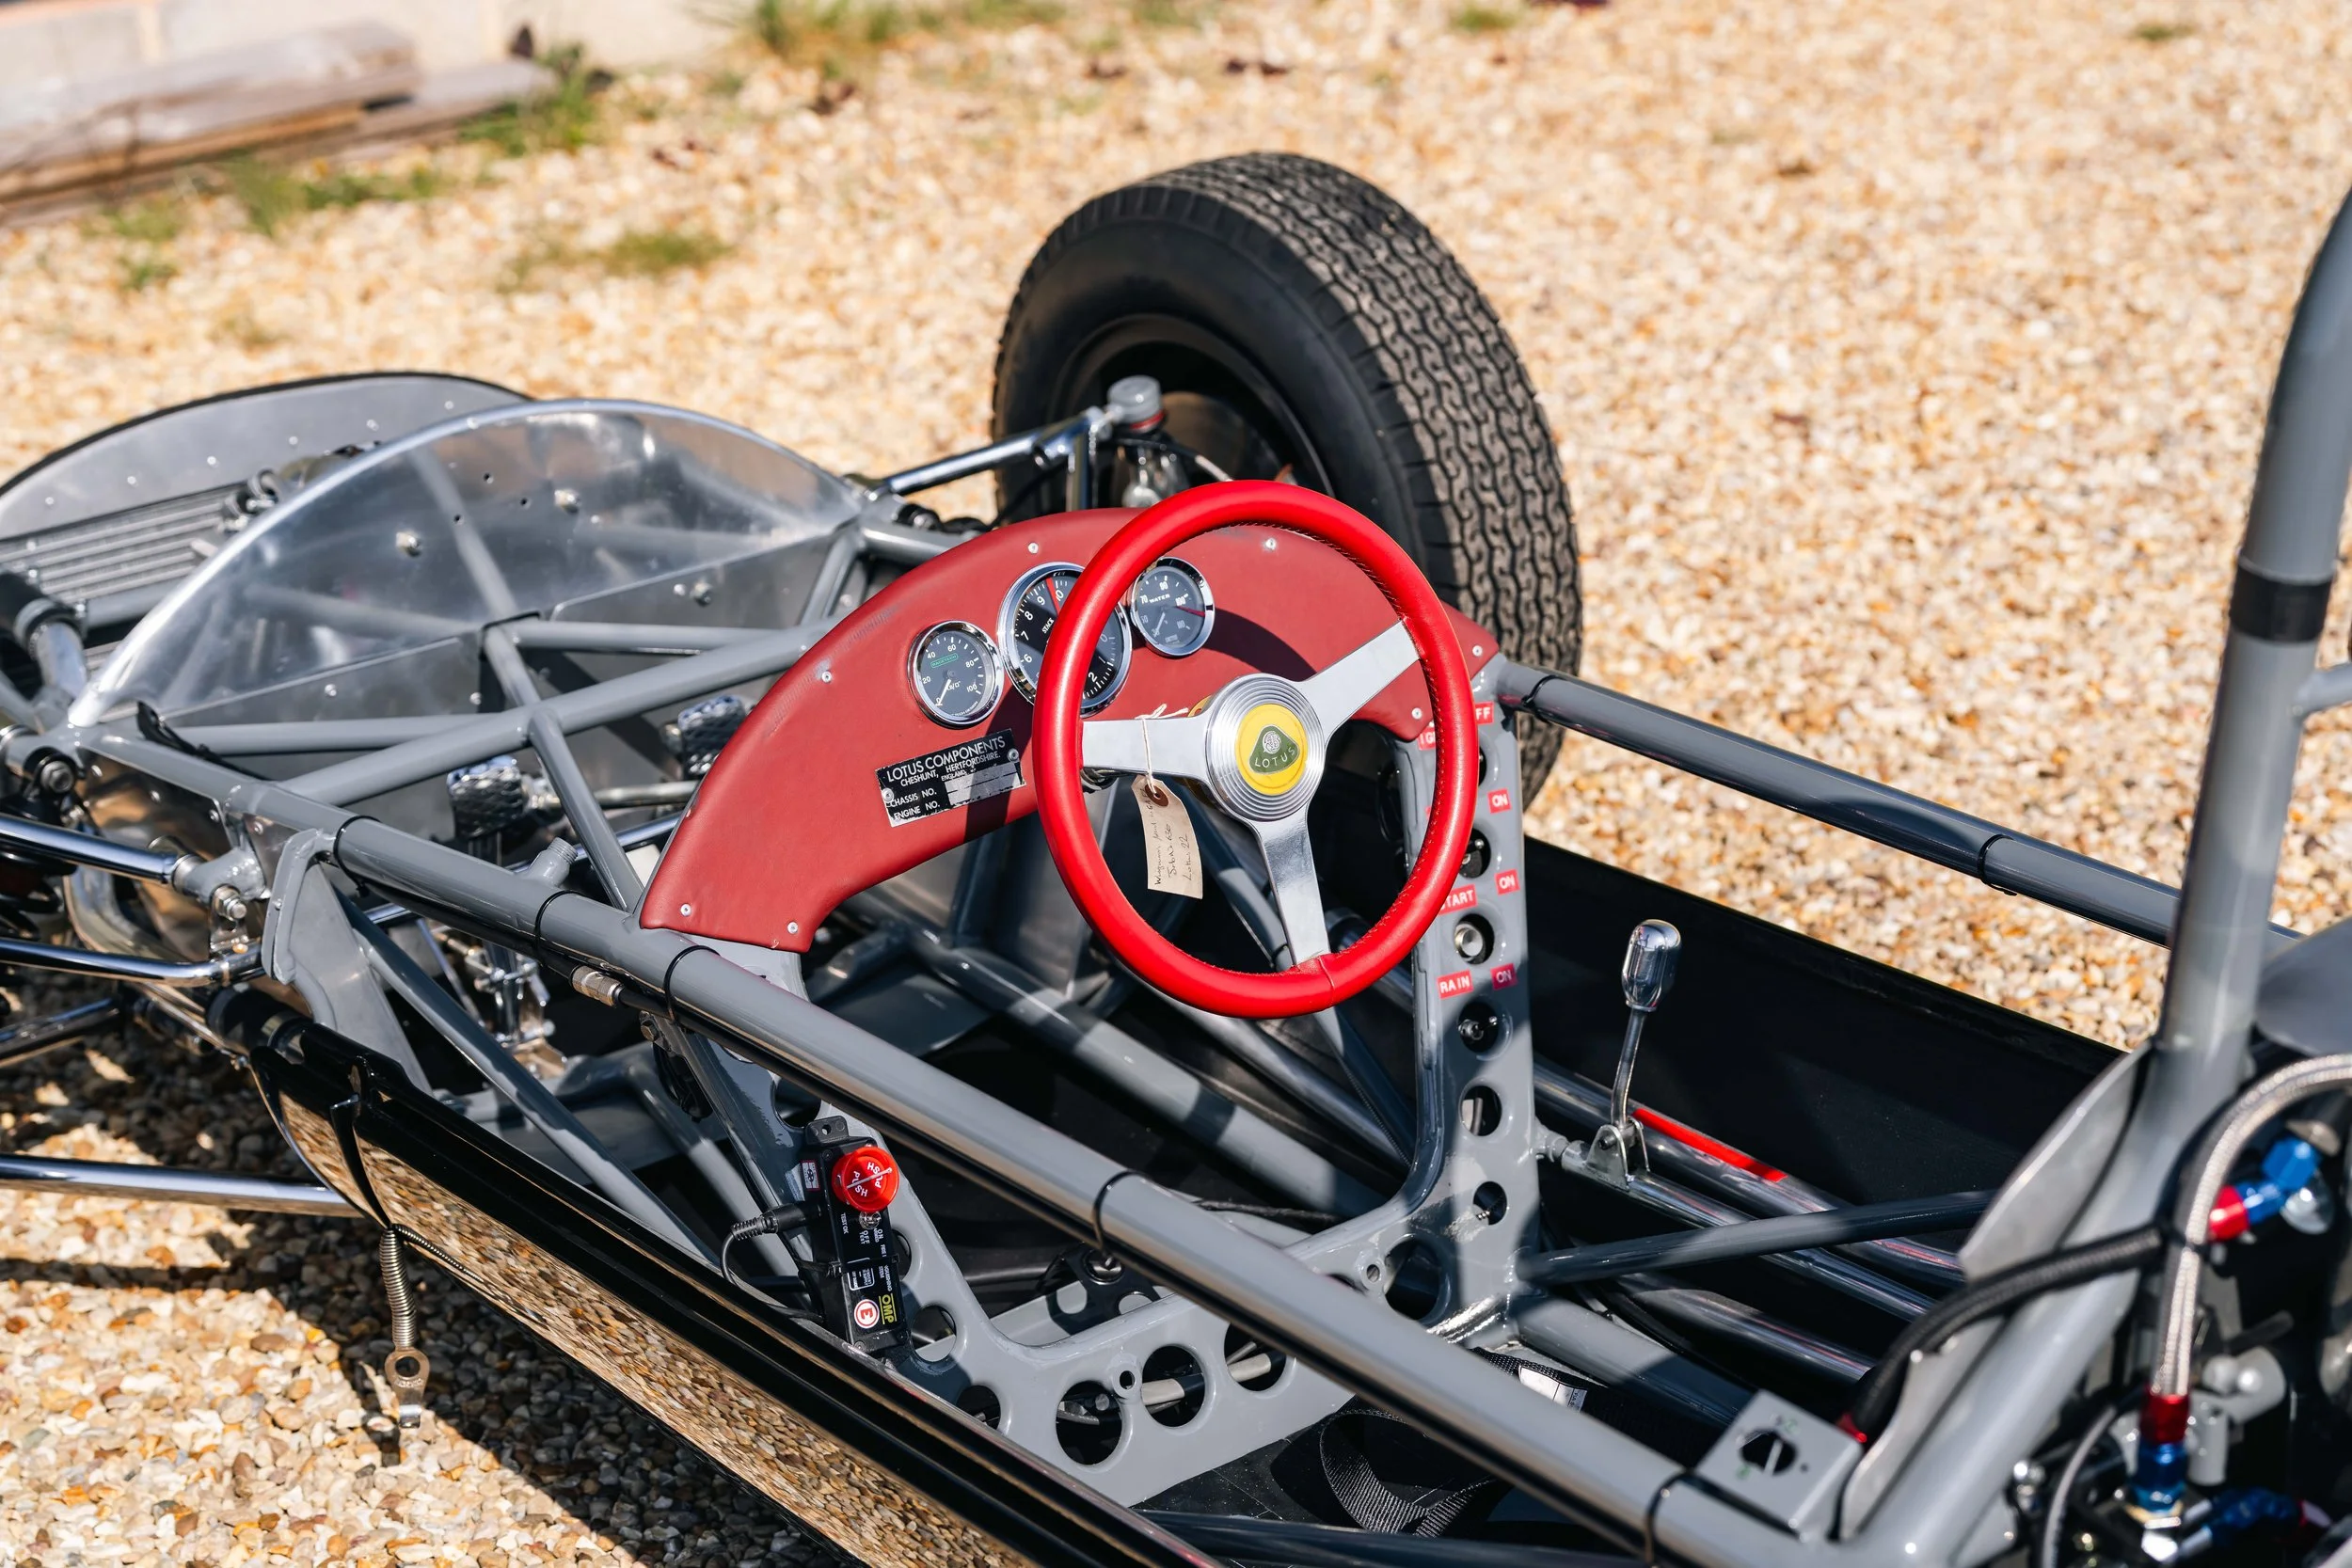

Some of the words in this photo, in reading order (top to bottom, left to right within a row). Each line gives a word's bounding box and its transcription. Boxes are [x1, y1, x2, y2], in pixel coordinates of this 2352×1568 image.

[1037, 596, 1045, 606] 9
[1055, 589, 1064, 602] 10
[1140, 594, 1149, 605] 70
[1149, 594, 1170, 604] WATER
[1024, 611, 1034, 621] 8
[1041, 617, 1055, 634] STACK
[1021, 630, 1029, 641] 7
[947, 643, 957, 652] 60
[927, 651, 936, 659] 40
[1024, 654, 1033, 663] 6
[965, 659, 975, 668] 80
[922, 675, 931, 685] 20
[1088, 672, 1098, 683] 2
[966, 684, 977, 692] 100
[1475, 706, 1491, 721] FF
[1420, 731, 1436, 745] IG
[886, 760, 924, 783] LOTUS
[926, 736, 1006, 769] COMPONENTS
[1254, 746, 1295, 768] LOTUS
[900, 769, 939, 787] CHESHUNT,
[945, 752, 1001, 773] HERTFORDSHIRE.
[890, 794, 918, 808] CHASSIS
[922, 787, 937, 798] NO.
[1491, 794, 1508, 807] ON
[894, 806, 921, 820] ENGINE
[926, 800, 941, 810] NO.
[1499, 875, 1516, 889] ON
[1495, 969, 1513, 983] ON
[1438, 975, 1471, 992] RAIN
[842, 1226, 849, 1234] OK
[877, 1228, 884, 1240] ON
[860, 1307, 873, 1321] E
[882, 1294, 894, 1323] OMP
